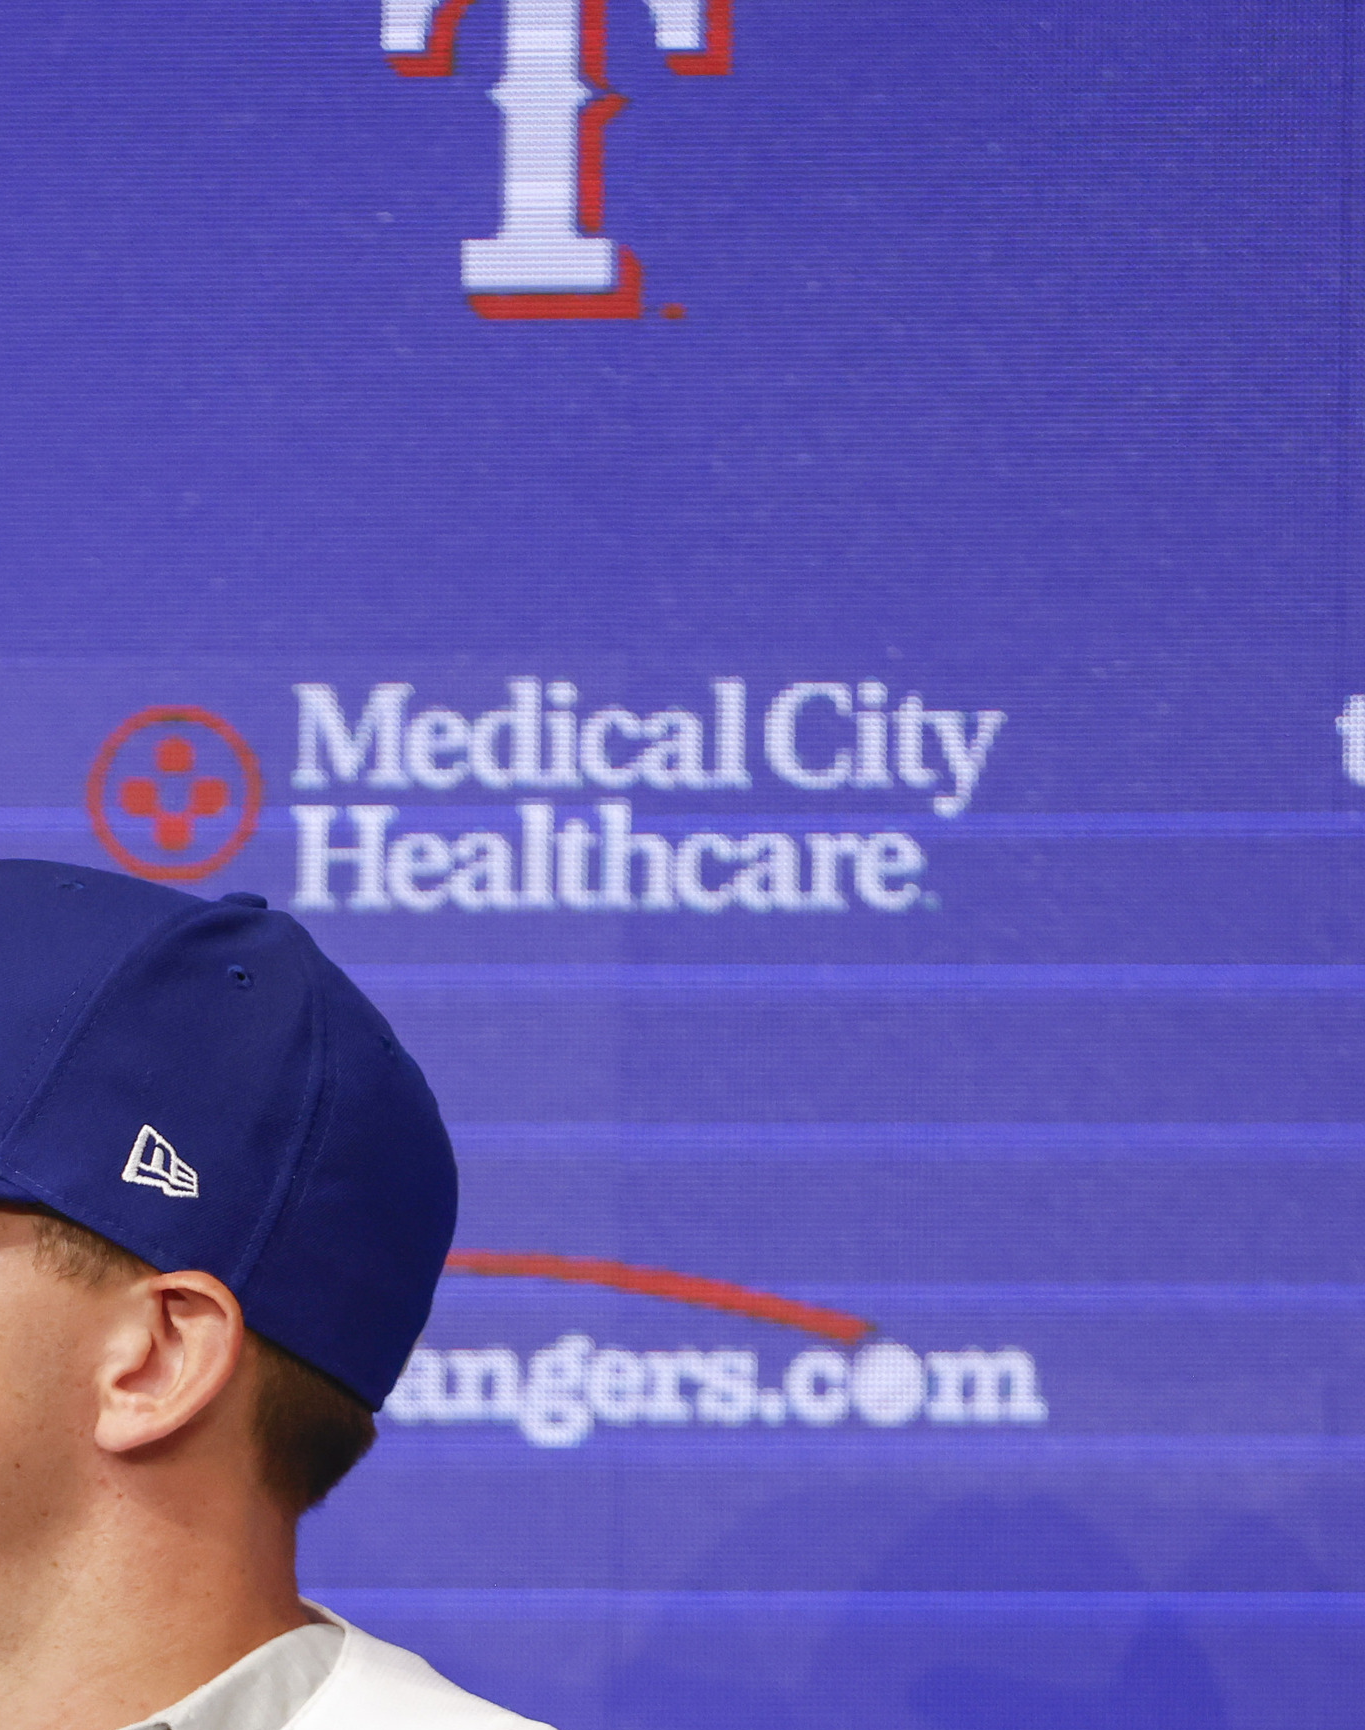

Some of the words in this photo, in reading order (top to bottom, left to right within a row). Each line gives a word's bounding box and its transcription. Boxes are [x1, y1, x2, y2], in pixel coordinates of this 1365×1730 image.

[290, 674, 751, 791] Medical
[763, 681, 1007, 818] City
[288, 799, 929, 912] Healthcare
